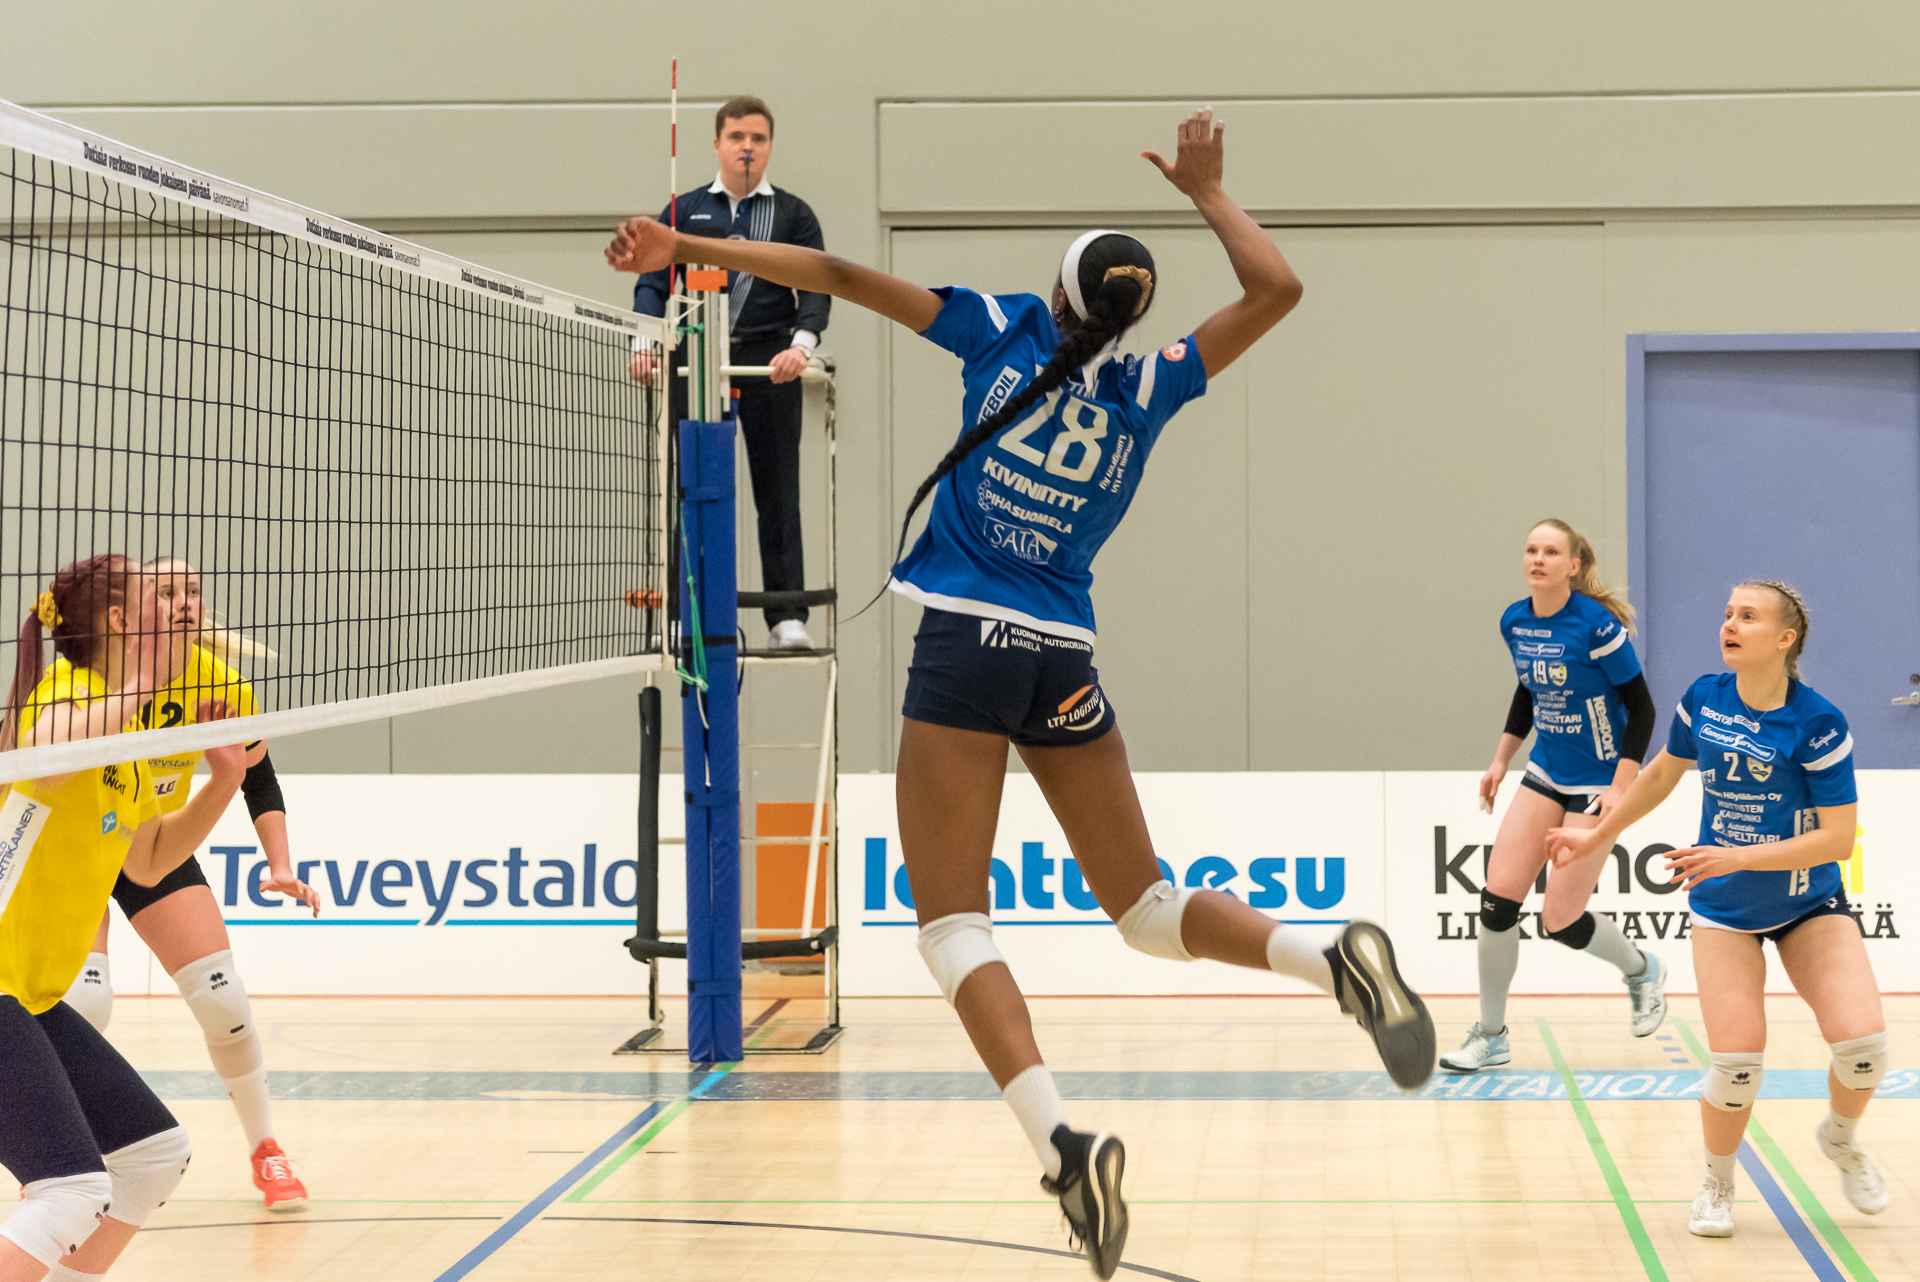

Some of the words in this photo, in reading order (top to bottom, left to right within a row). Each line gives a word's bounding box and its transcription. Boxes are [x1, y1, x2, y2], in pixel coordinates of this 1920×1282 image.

[108, 155, 137, 176] verkossa
[997, 386, 1109, 483] 28
[985, 489, 1073, 534] PIHASUOMELA
[990, 523, 1042, 557] SATA
[1010, 636, 1042, 653] MÄKELÄ
[1532, 660, 1549, 685] 19
[1047, 715, 1067, 729] LTP
[1723, 752, 1742, 782] 2
[209, 843, 639, 927] Terveystalo
